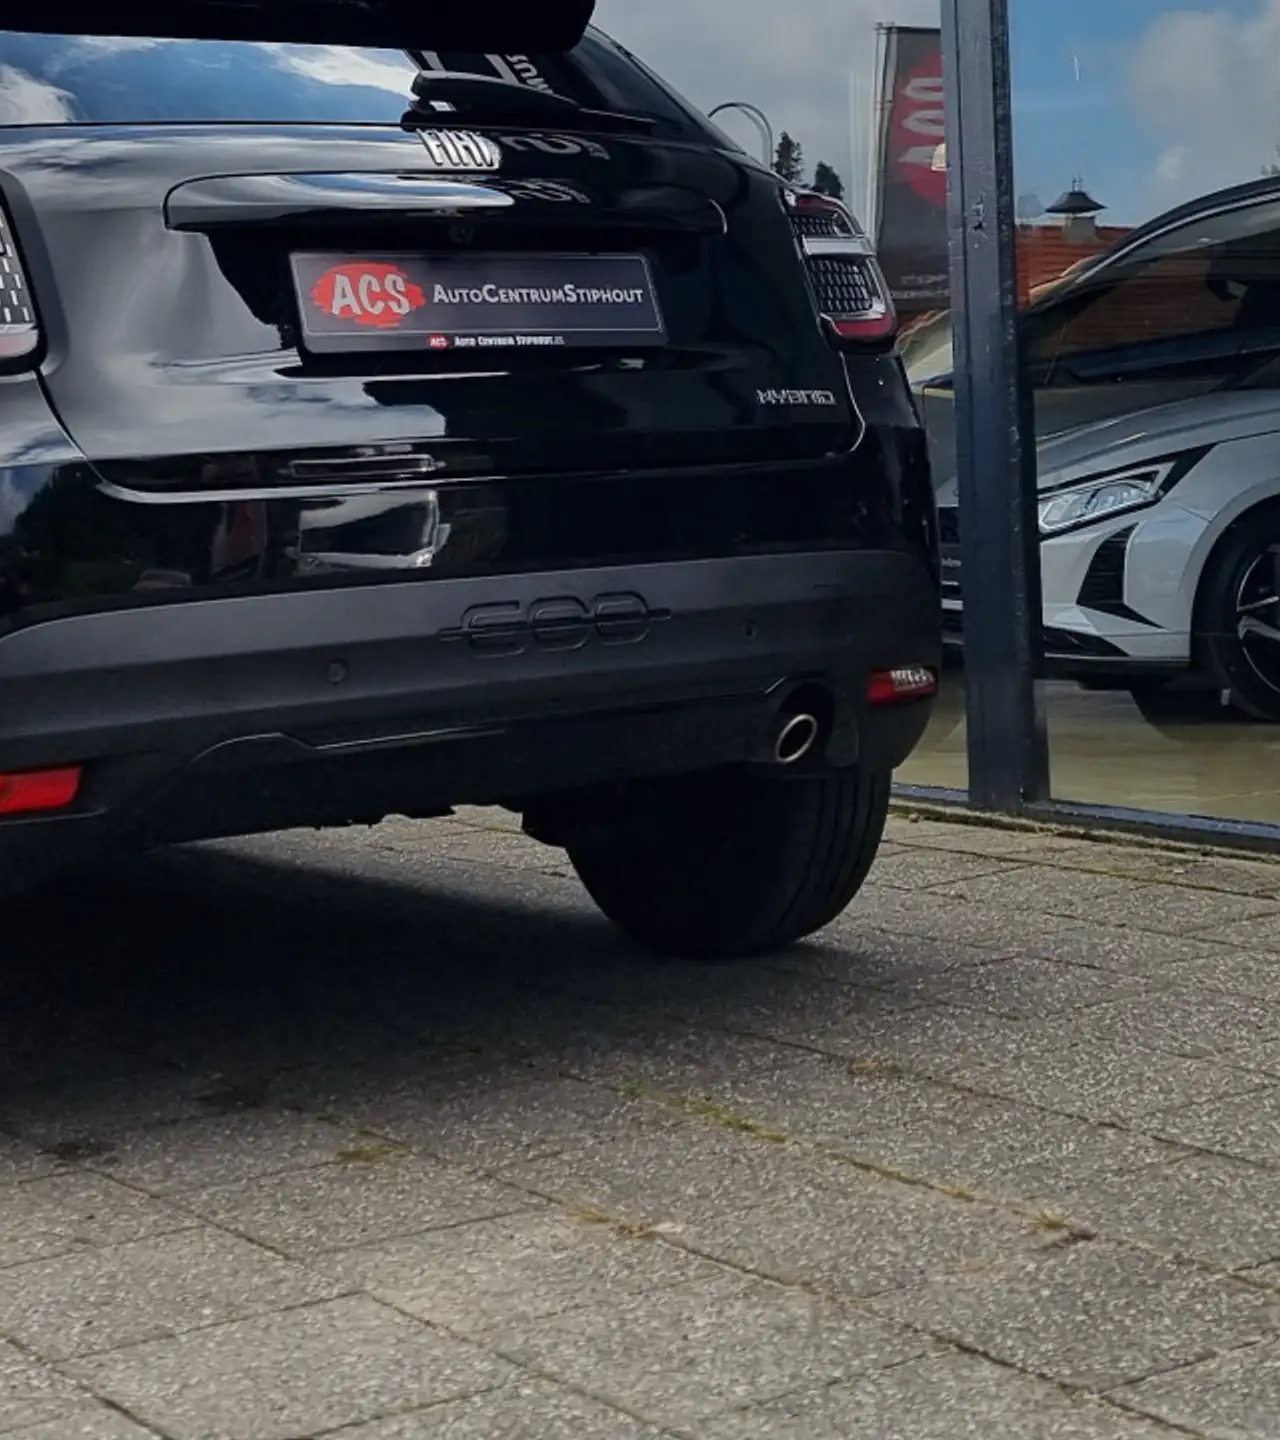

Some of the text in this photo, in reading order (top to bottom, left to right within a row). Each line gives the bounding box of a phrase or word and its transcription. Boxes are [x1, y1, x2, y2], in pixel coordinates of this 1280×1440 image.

[417, 127, 495, 167] FIAT
[331, 273, 412, 316] ACS
[756, 389, 837, 405] HYBRID
